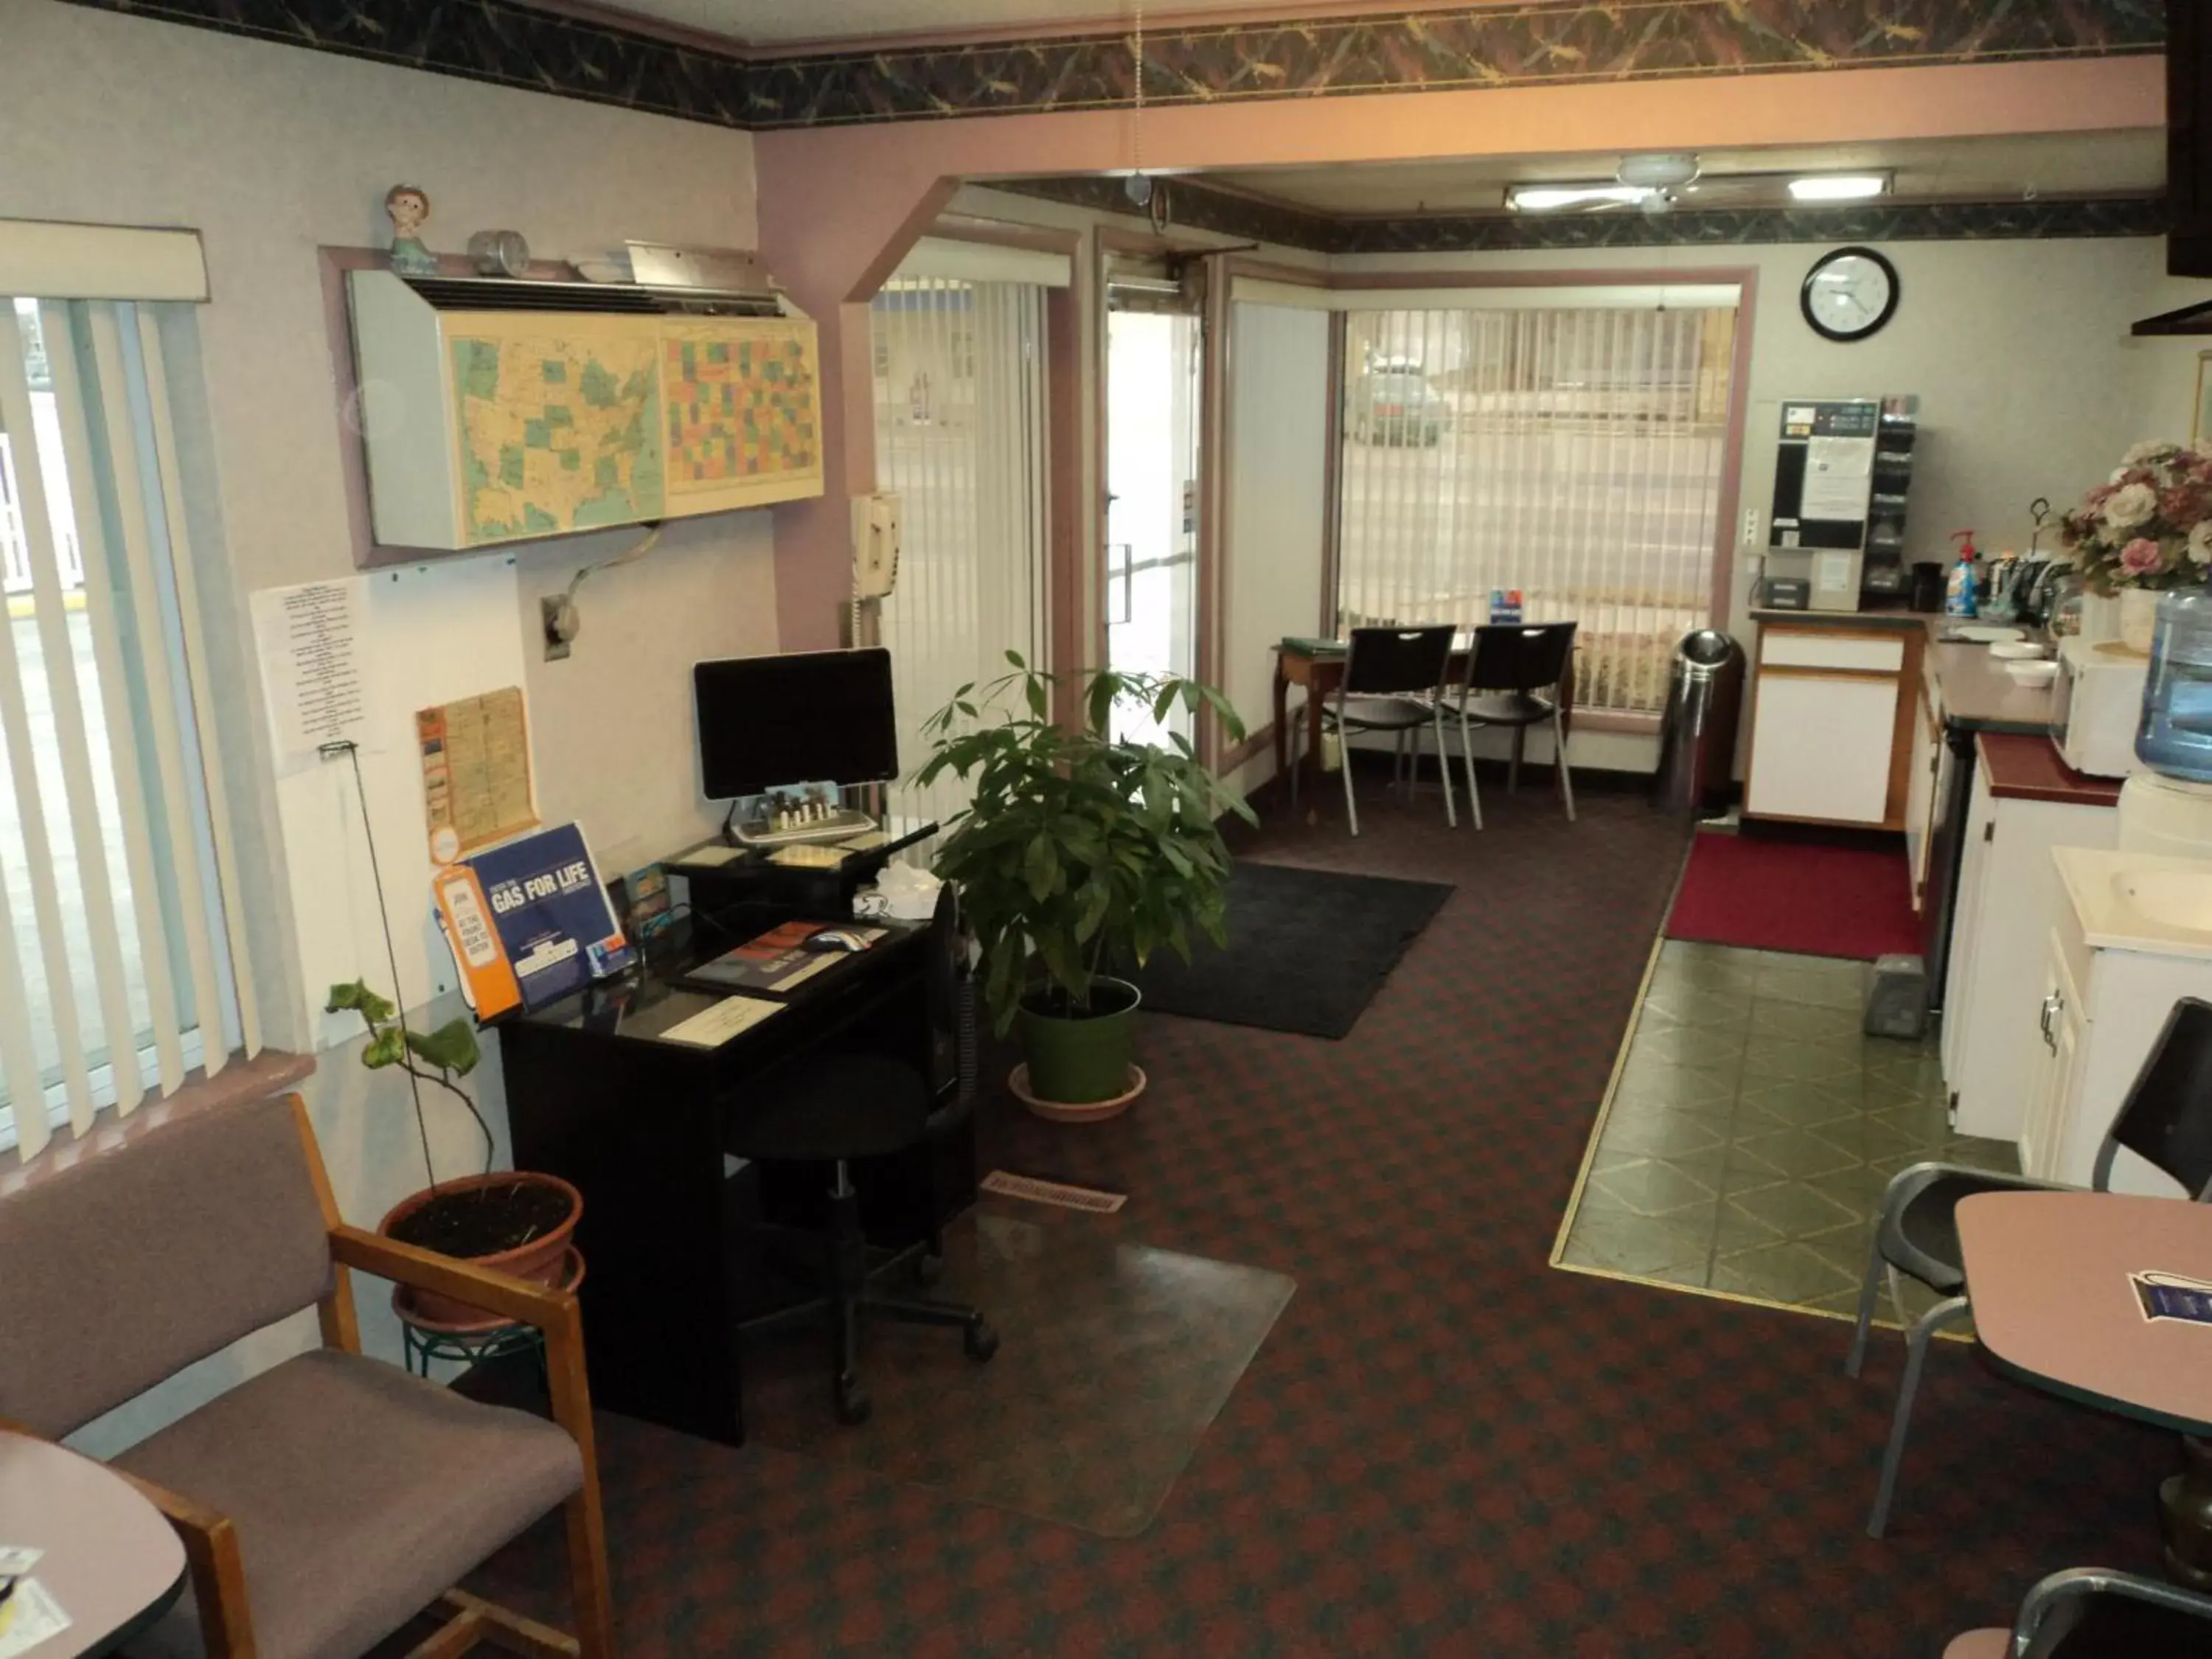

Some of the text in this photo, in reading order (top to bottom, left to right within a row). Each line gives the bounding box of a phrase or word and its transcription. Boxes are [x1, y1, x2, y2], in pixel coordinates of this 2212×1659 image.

[491, 886, 526, 914] GAS
[524, 874, 557, 900] FOR
[556, 861, 589, 887] LIFE
